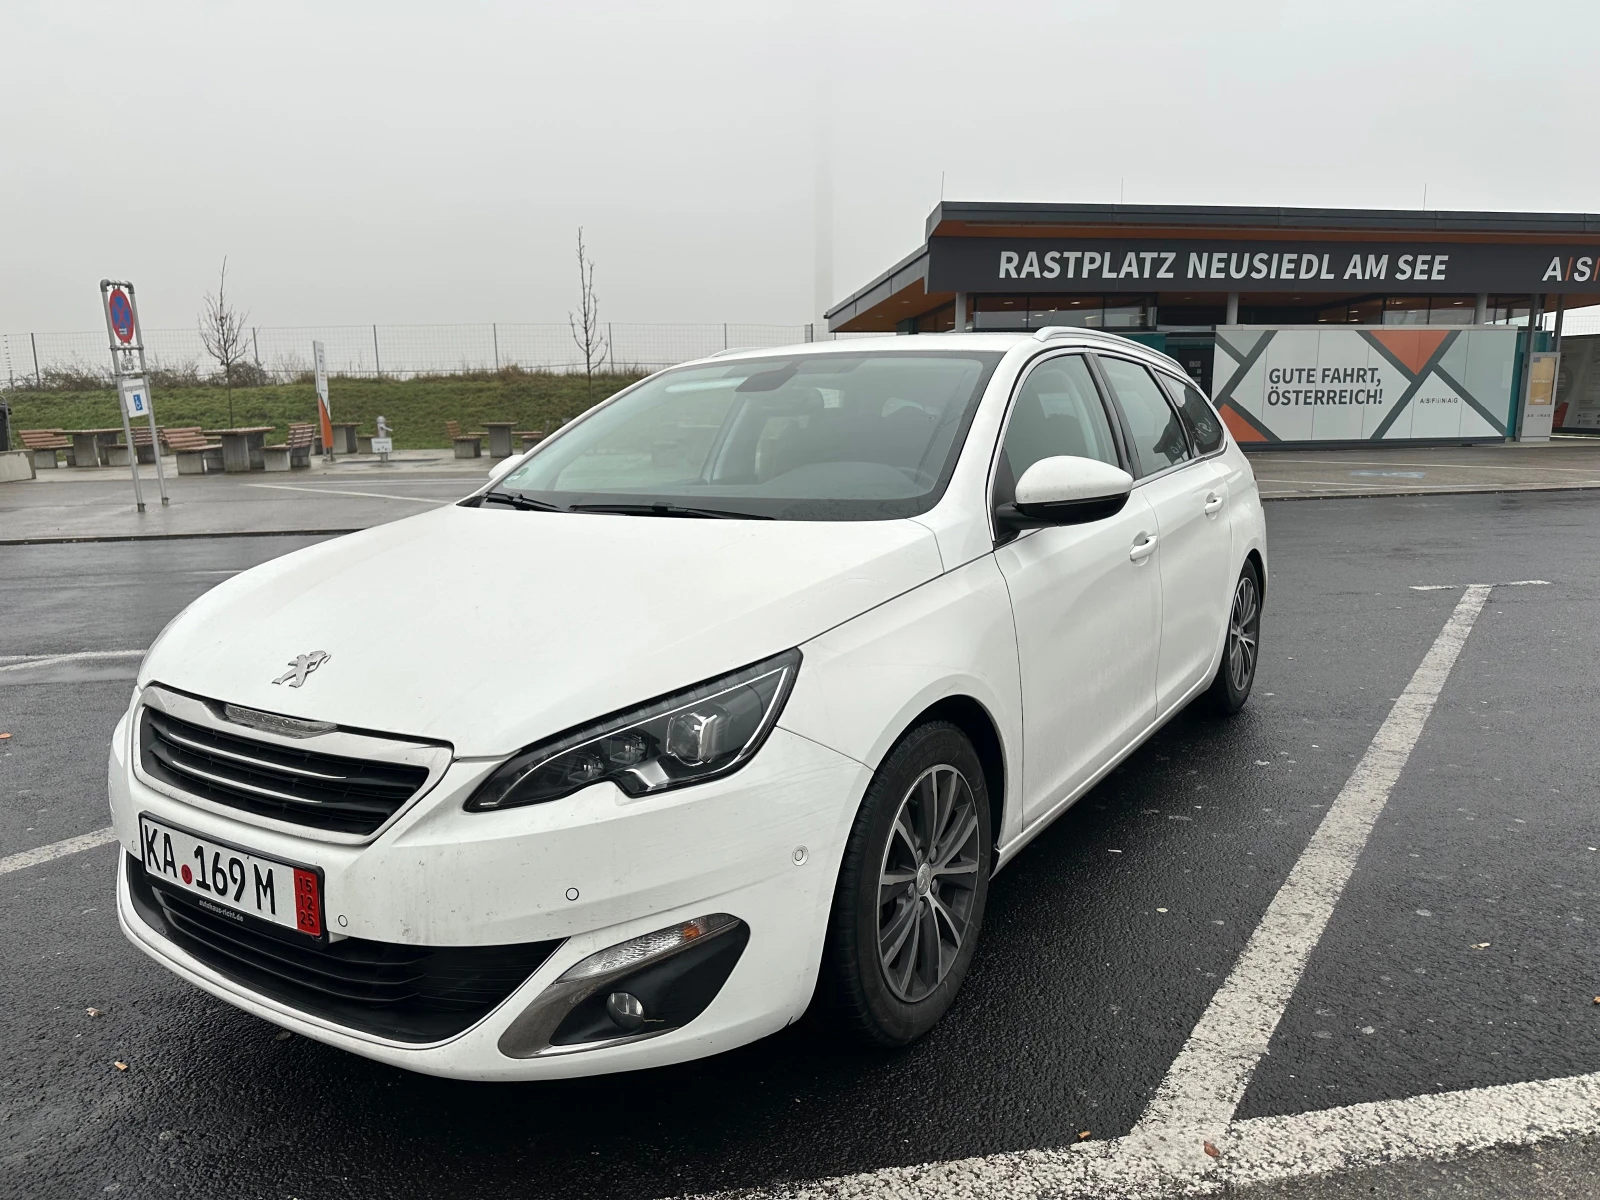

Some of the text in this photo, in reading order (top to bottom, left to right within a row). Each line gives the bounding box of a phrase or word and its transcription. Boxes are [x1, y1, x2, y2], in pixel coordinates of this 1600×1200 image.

[998, 250, 1449, 281] RASTPLATZ NEUSIEDL AM SEE
[1268, 367, 1382, 387] GUTE FAHRT,
[1267, 386, 1383, 406] ÖSTERREICH!
[144, 824, 276, 915] KA 169 M
[298, 876, 312, 893] 15
[299, 894, 314, 911] 12
[300, 911, 315, 928] 25
